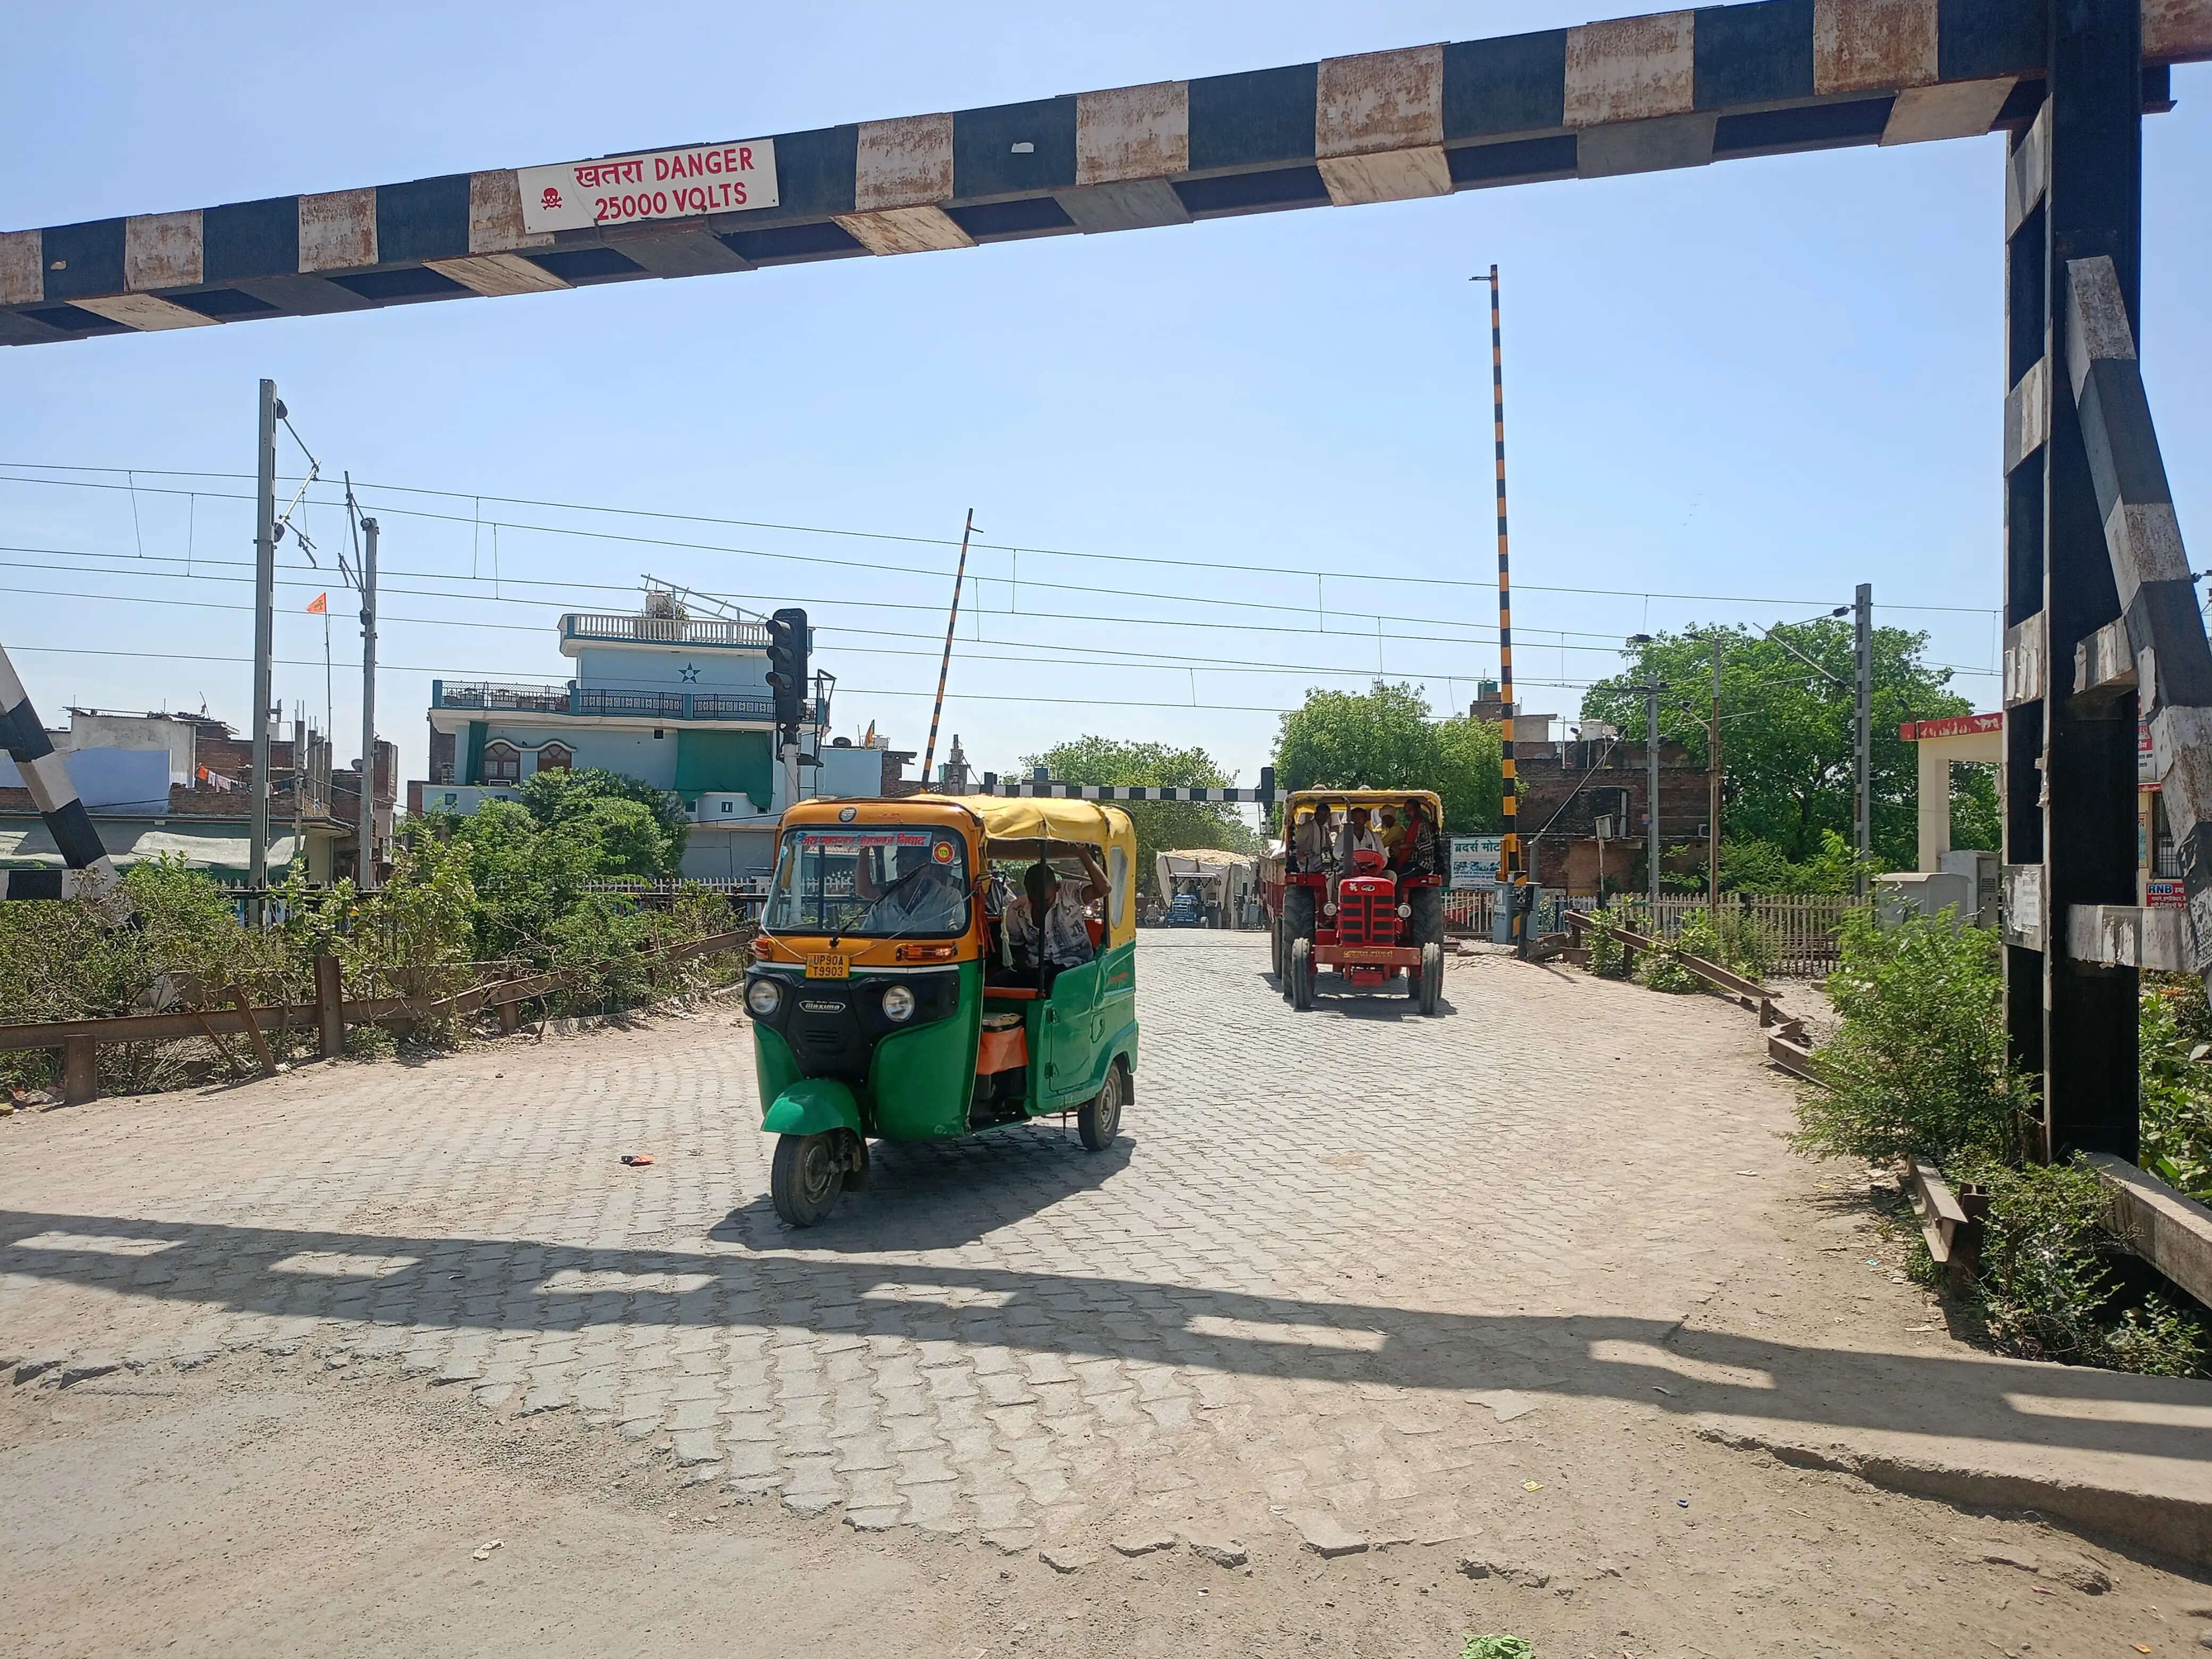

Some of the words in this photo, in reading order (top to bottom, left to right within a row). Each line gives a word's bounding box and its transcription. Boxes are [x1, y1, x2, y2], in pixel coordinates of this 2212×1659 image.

[574, 160, 644, 188] खतरा
[655, 147, 756, 181] DANGER
[594, 191, 667, 220] 25000
[672, 182, 747, 212] VOLTS
[1481, 839, 1501, 852] मोट
[2148, 884, 2173, 894] RNB
[814, 955, 843, 966] UP90A
[813, 967, 843, 976] T9903
